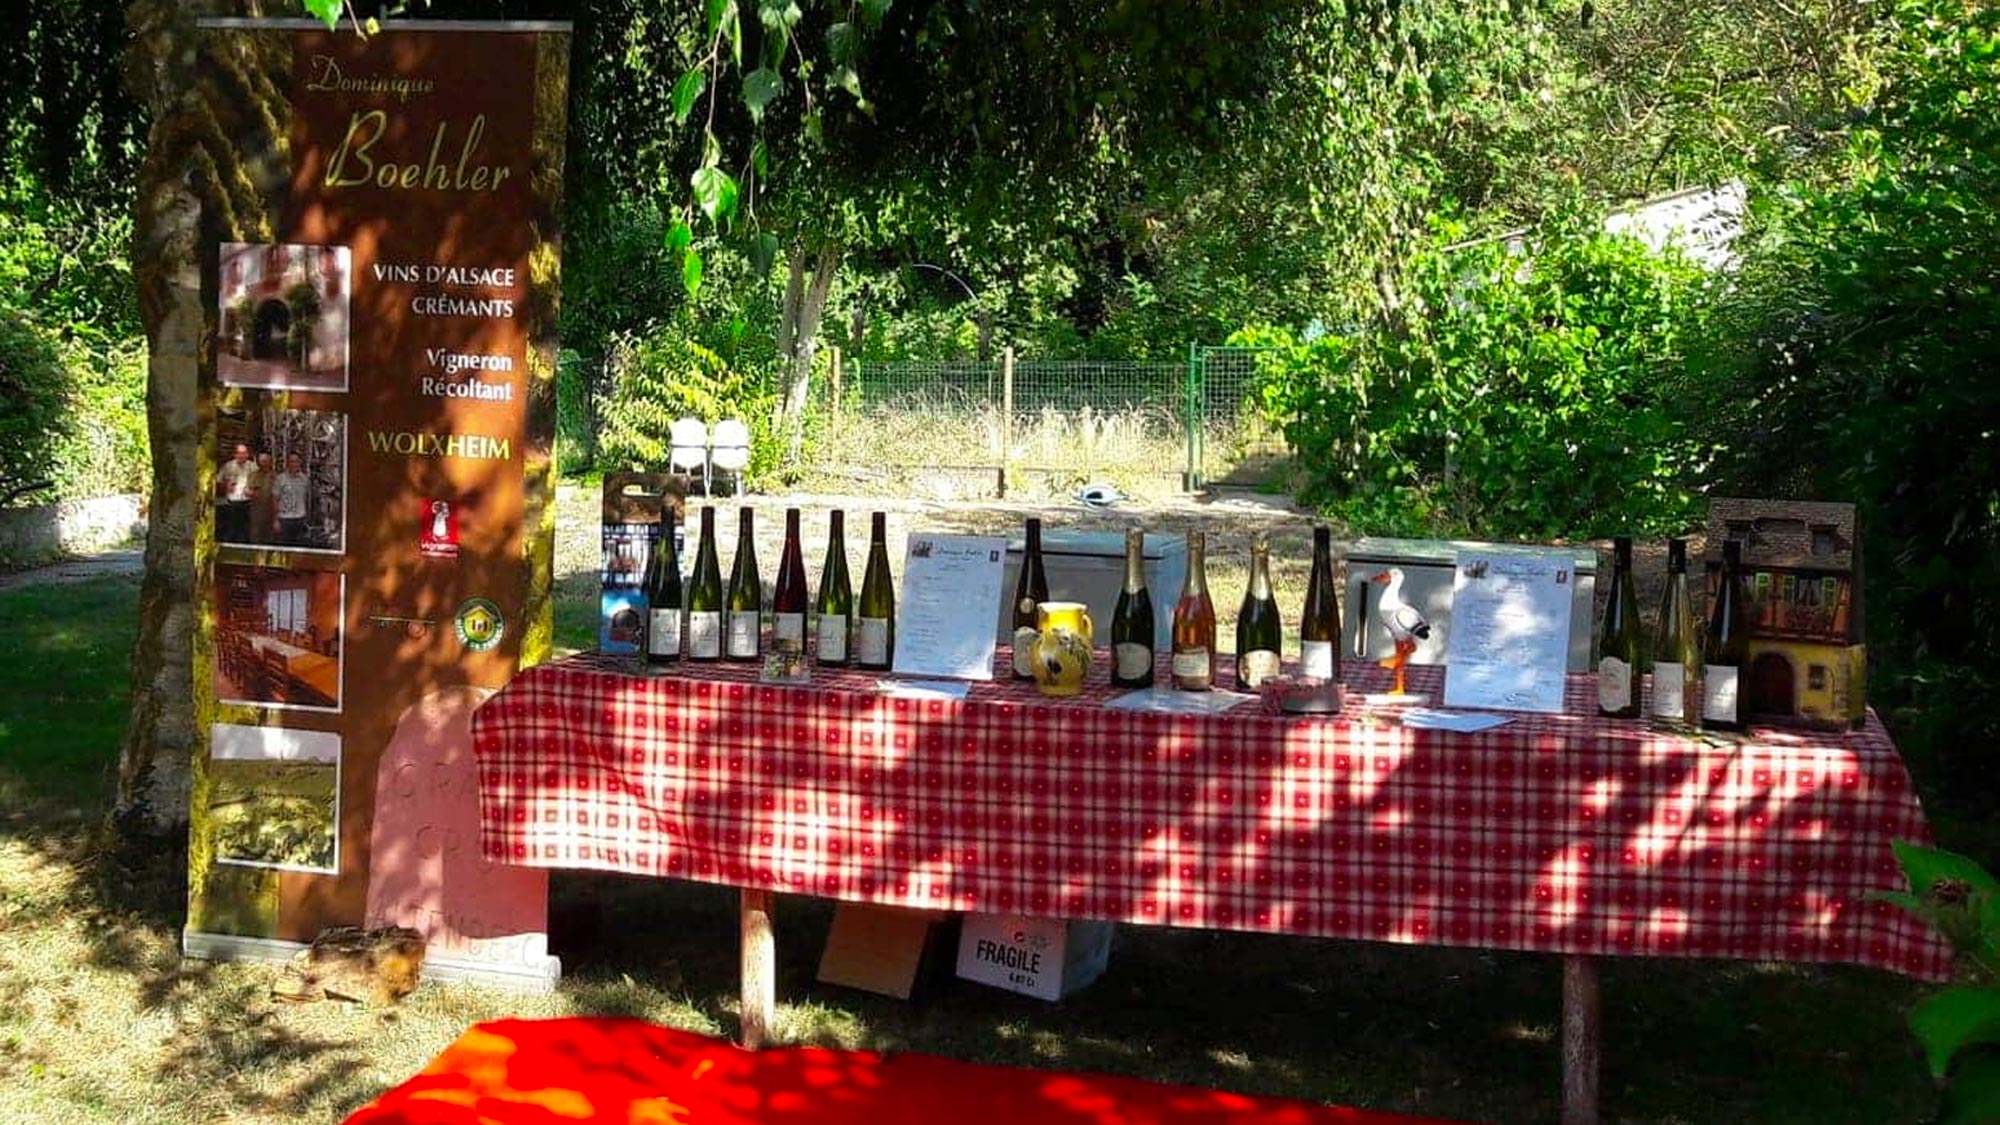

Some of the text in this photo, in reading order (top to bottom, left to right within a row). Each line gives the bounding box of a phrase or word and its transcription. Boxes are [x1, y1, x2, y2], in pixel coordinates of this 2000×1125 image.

[306, 54, 434, 102] Dominique
[325, 110, 510, 191] Boehler
[373, 264, 514, 287] VINS D'ALSACE
[412, 293, 514, 318] CRÉMANTS
[427, 349, 513, 374] Vigneron
[422, 377, 513, 401] Récoltant
[368, 432, 510, 460] WOLXHEIM
[976, 939, 1041, 974] FRAGILE
